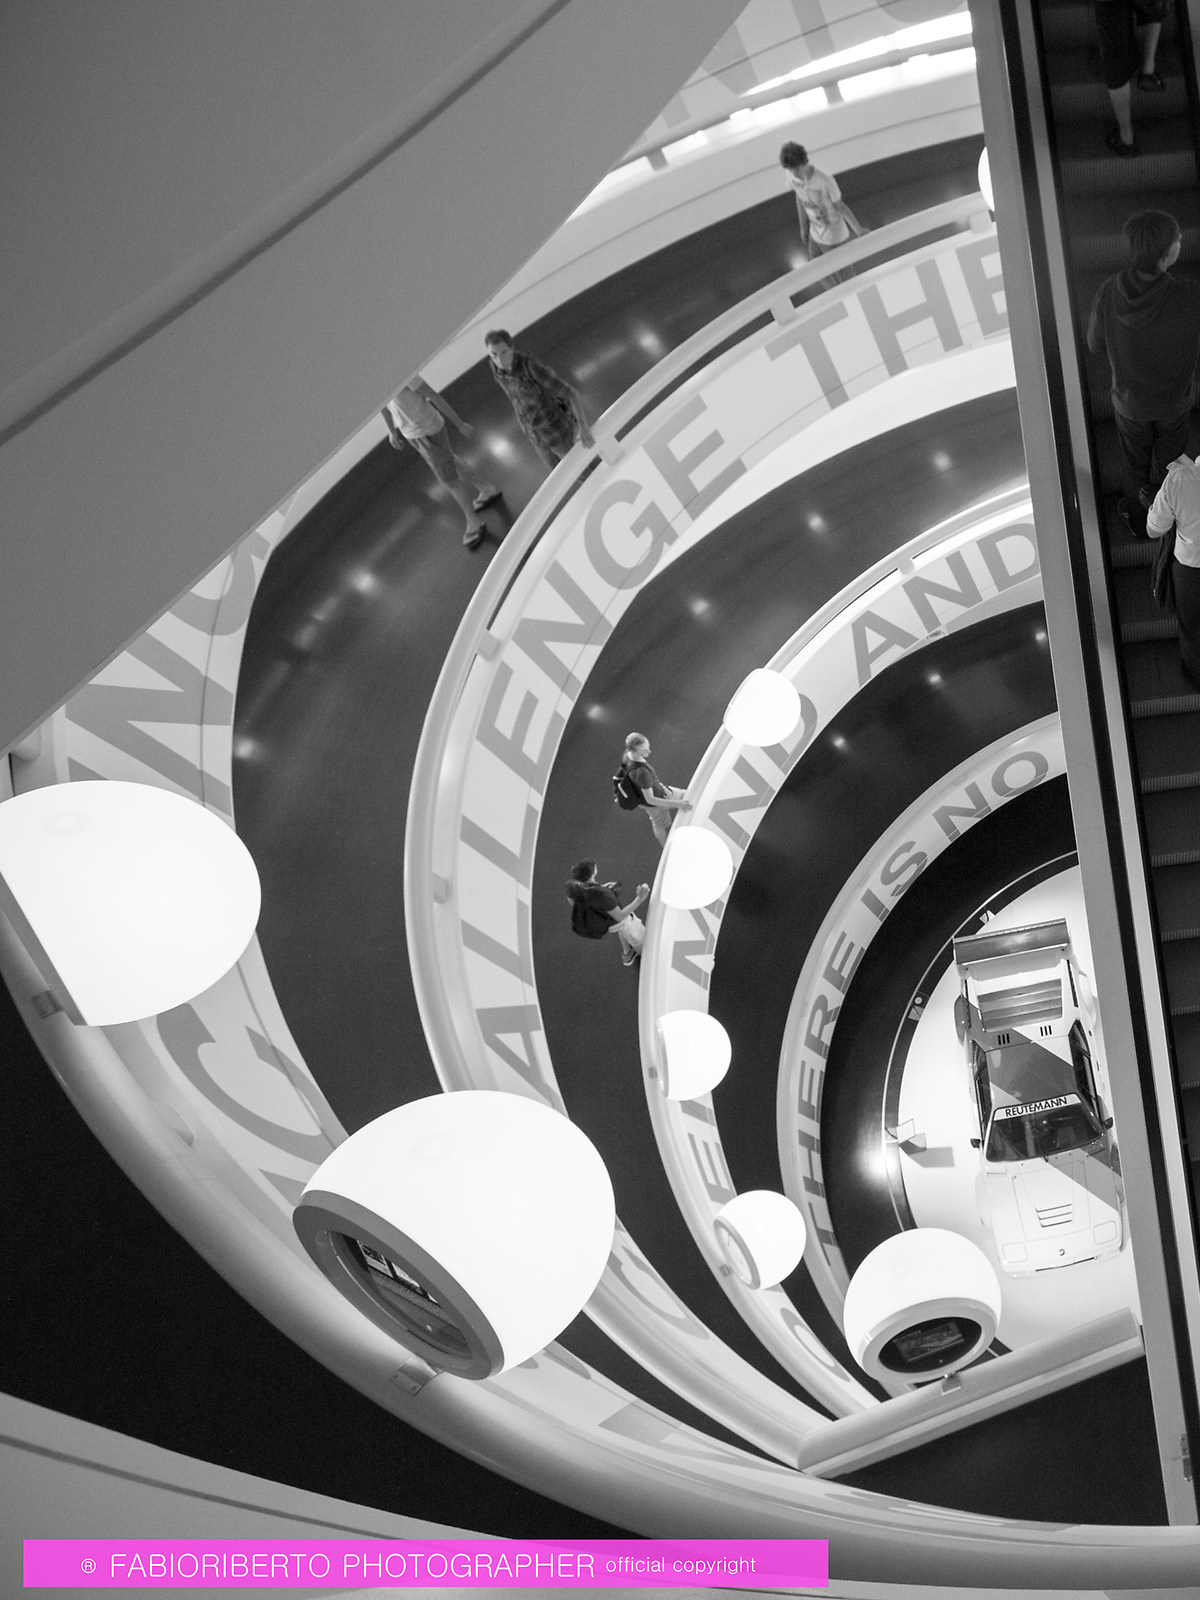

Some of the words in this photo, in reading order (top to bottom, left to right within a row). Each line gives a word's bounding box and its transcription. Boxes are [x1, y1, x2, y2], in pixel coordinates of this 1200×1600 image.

[764, 235, 1010, 410] THE
[671, 693, 818, 991] MND
[851, 522, 1042, 688] AND
[798, 931, 866, 1268] THERE
[860, 840, 929, 923] IS
[931, 750, 1050, 843] NO
[1004, 1096, 1068, 1118] REUTEMANN
